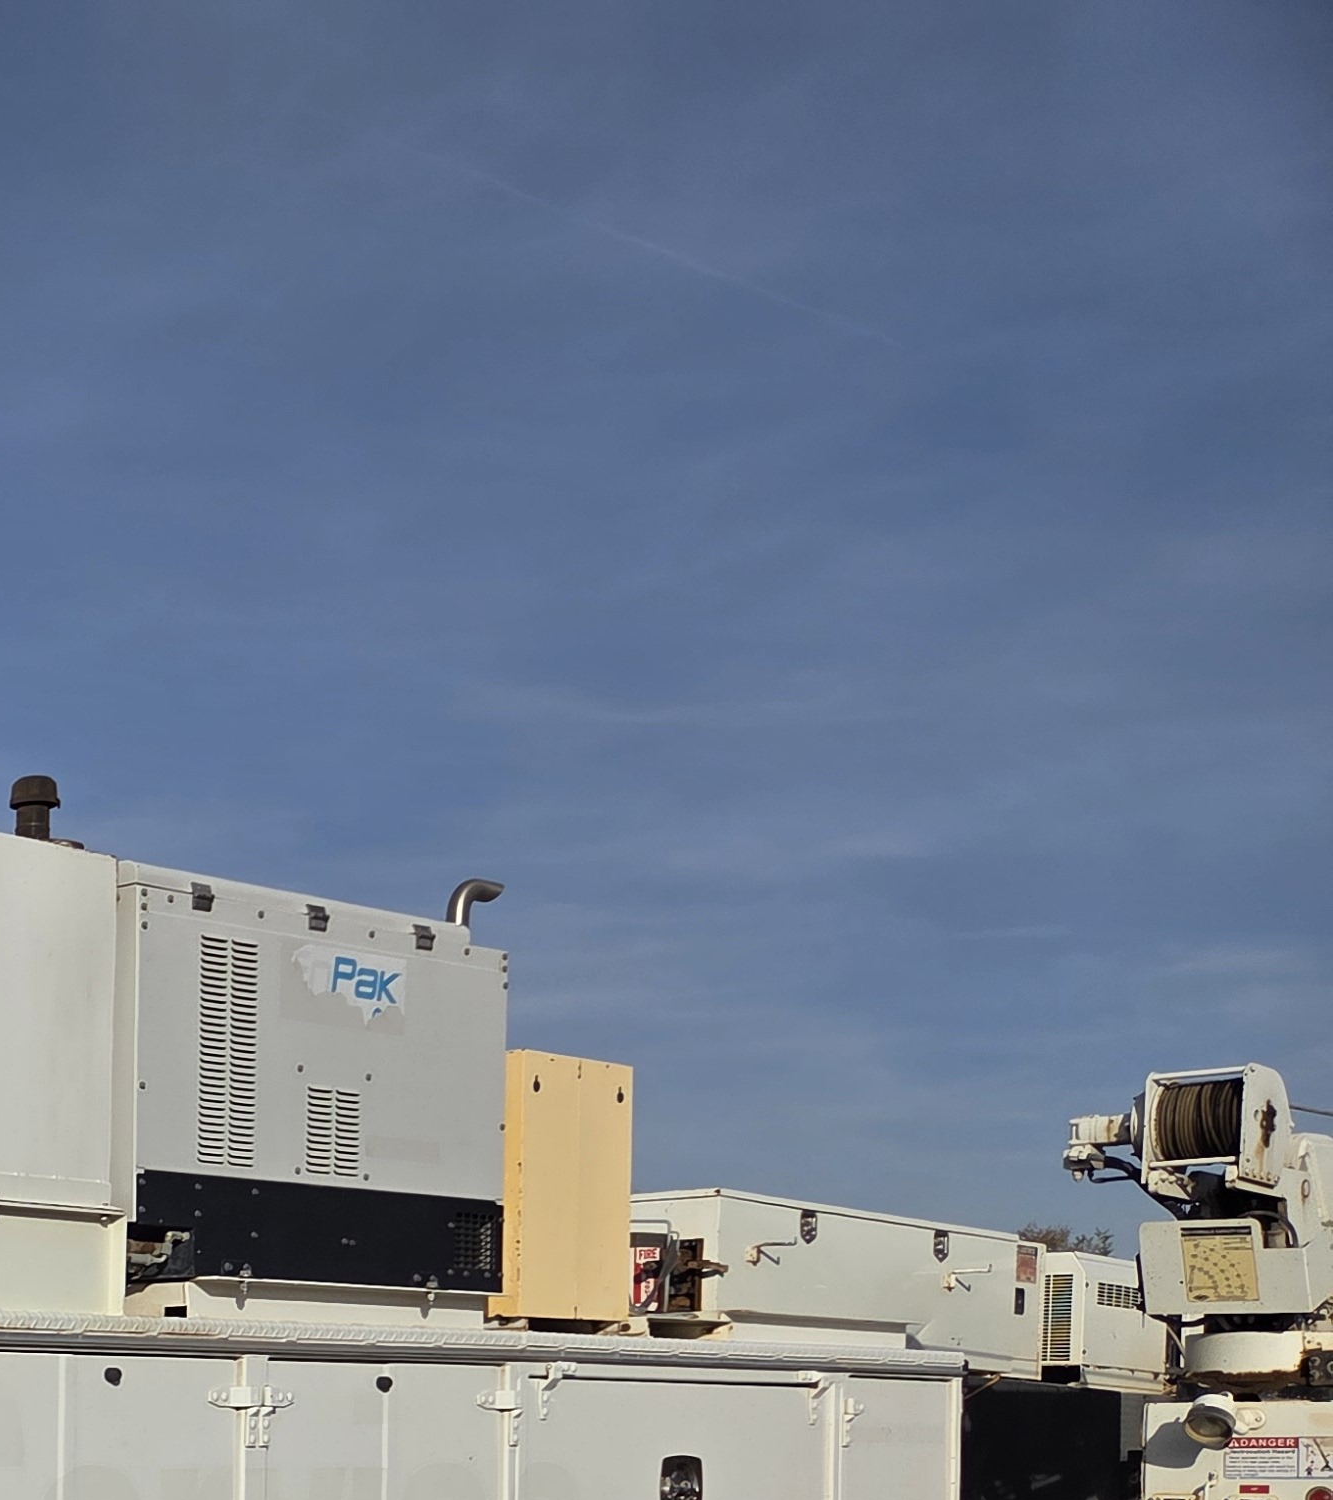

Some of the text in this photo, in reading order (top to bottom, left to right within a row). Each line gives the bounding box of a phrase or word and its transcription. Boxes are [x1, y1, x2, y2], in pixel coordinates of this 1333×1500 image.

[331, 956, 402, 1005] Pak
[639, 1247, 658, 1261] FIRE
[1240, 1438, 1295, 1447] DANGER
